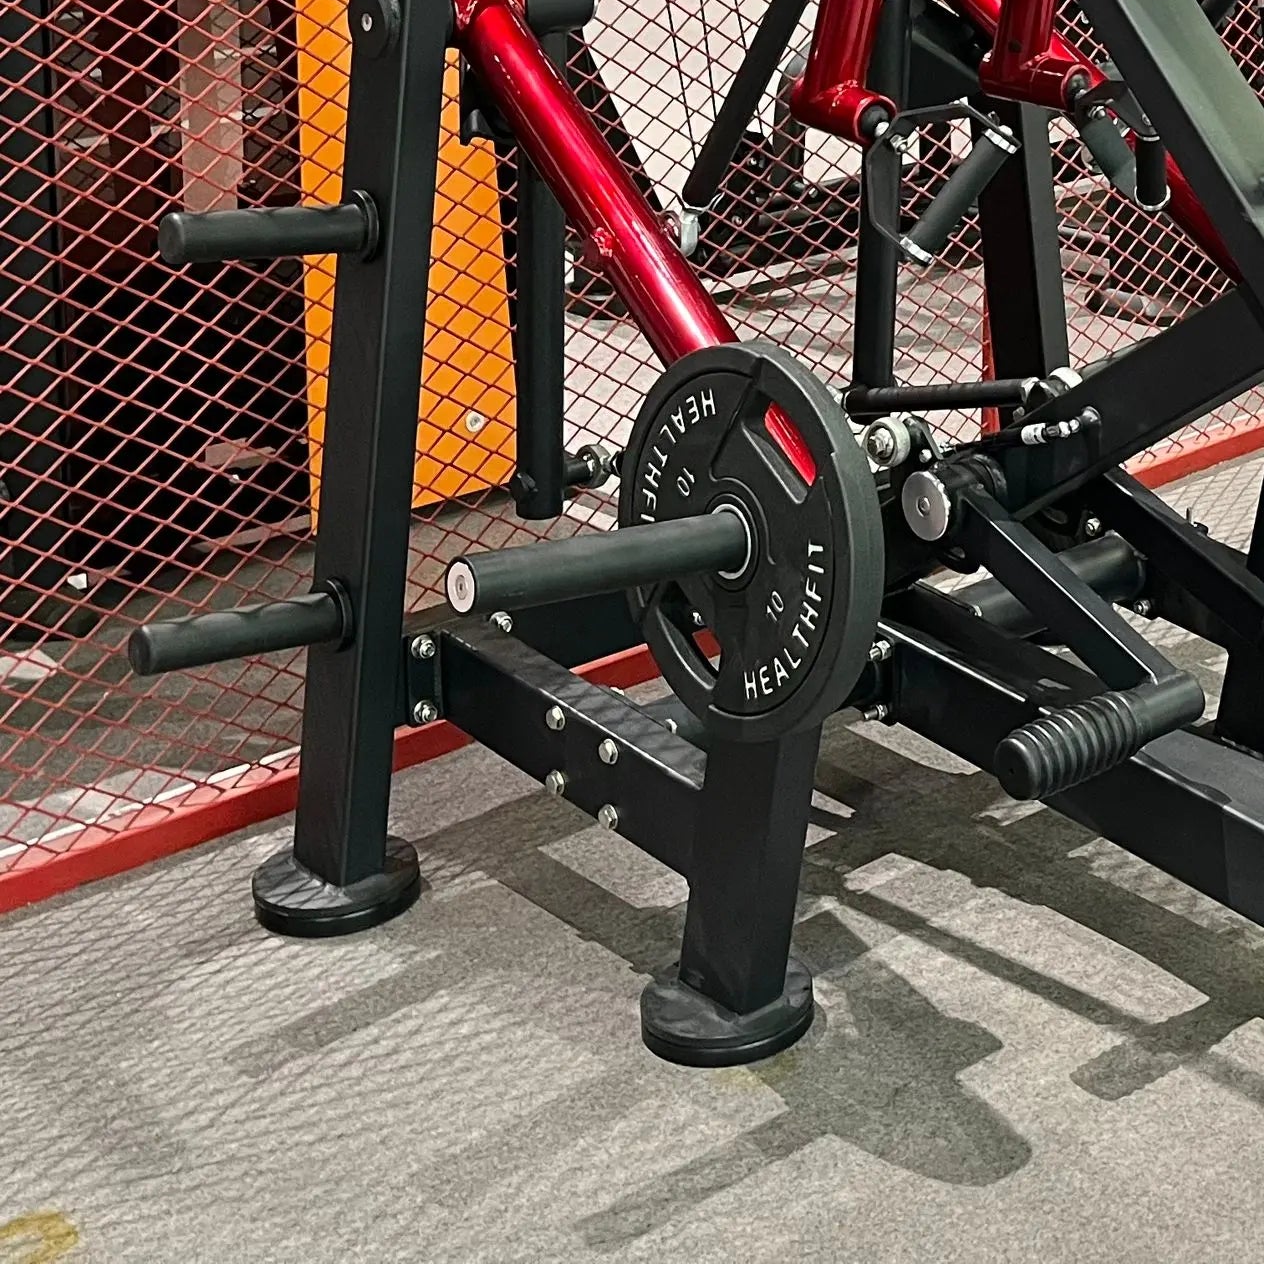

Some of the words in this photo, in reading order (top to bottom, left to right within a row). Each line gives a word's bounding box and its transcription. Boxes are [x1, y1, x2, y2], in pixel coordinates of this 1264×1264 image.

[640, 388, 716, 523] HEALTHFI
[677, 467, 695, 497] 10
[743, 540, 825, 701] HEALTHFIT
[766, 590, 785, 623] 10
